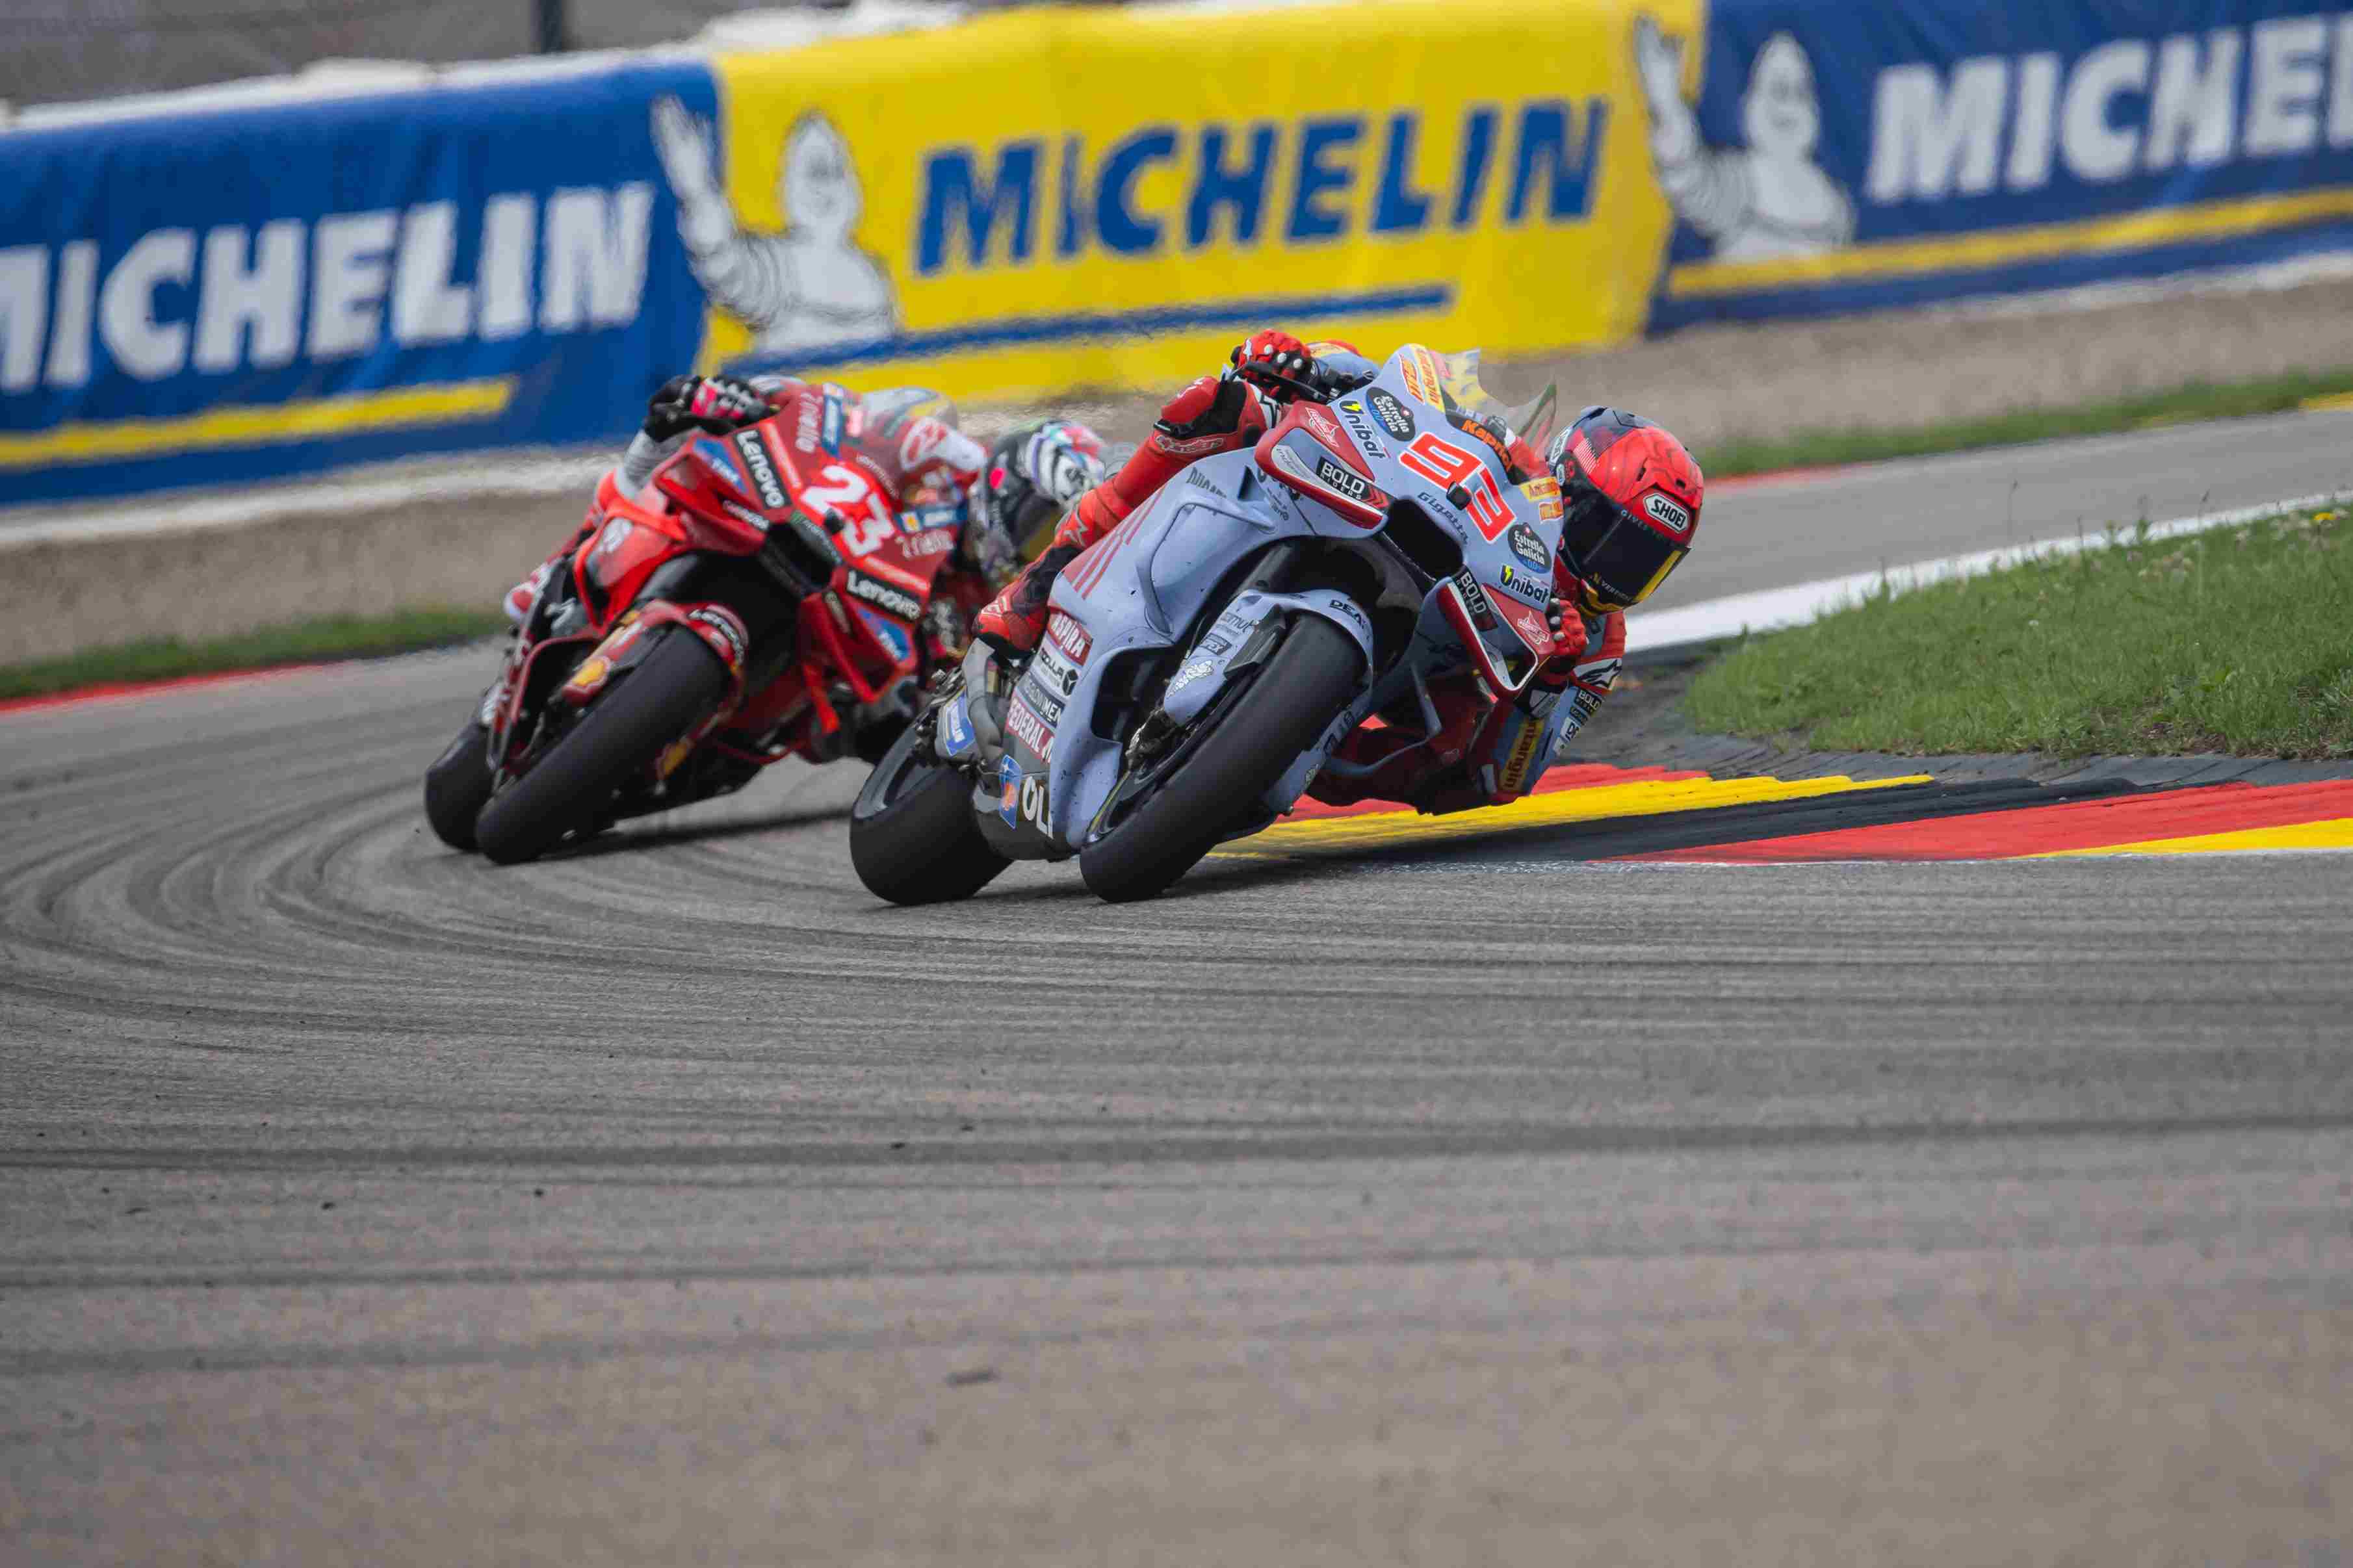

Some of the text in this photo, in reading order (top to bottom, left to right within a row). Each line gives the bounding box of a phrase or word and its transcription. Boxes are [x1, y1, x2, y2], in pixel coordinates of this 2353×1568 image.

[916, 97, 1608, 278] MICHELIN
[1339, 400, 1388, 459] Unibat
[1373, 396, 1398, 433] Galicia
[1381, 395, 1410, 433] Estrella
[737, 430, 785, 508] Lenovo
[1320, 461, 1366, 495] BOLD
[1398, 431, 1517, 544] 93
[800, 464, 894, 556] 23
[1651, 498, 1687, 528] SHOEI
[1514, 530, 1545, 554] Estrella
[1516, 541, 1546, 565] Galicia
[846, 569, 921, 619] Lenovo
[1459, 572, 1487, 613] BOLD
[1500, 564, 1550, 604] Unibat
[1008, 697, 1046, 754] FEDERAL
